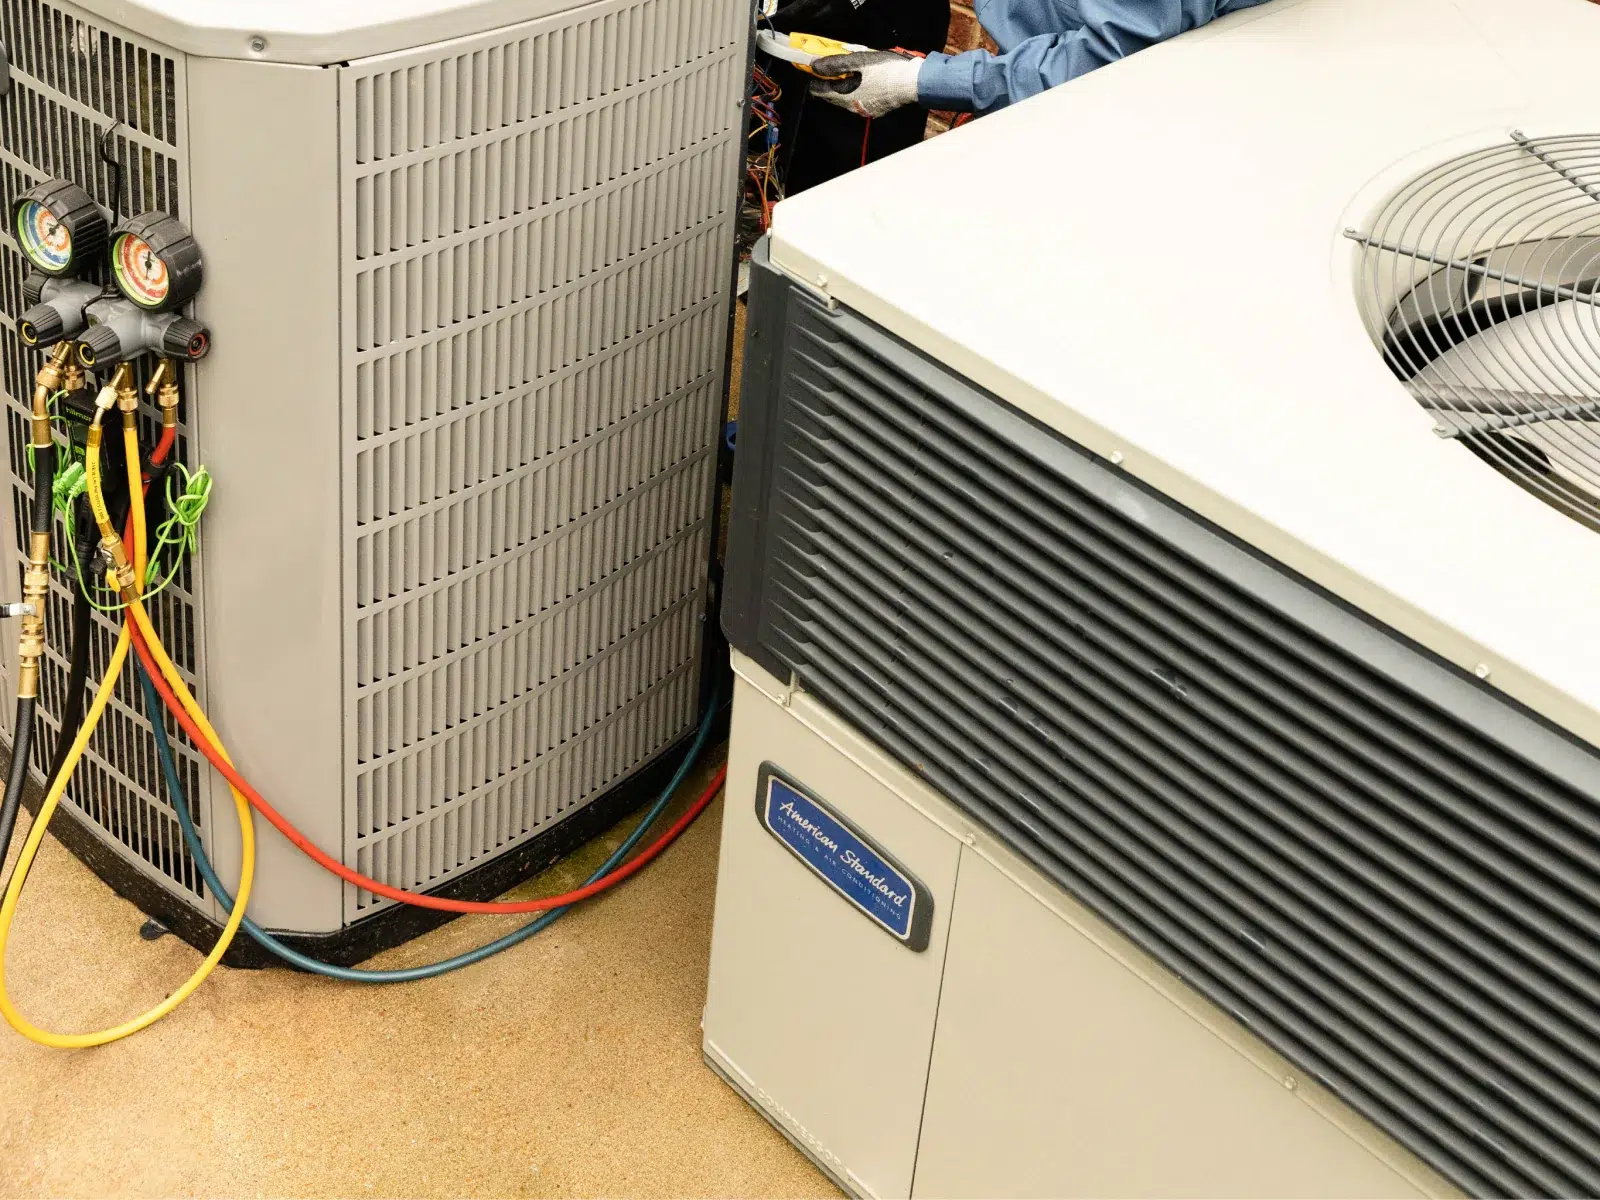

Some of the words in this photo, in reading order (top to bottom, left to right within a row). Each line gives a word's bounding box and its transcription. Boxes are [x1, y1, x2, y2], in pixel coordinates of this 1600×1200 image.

[777, 815, 811, 845] HEATING
[823, 854, 837, 867] AIR
[841, 868, 901, 920] CONDITIONING
[779, 799, 839, 853] American
[840, 849, 908, 908] Standard
[757, 1086, 843, 1169] COMPRESSOR
